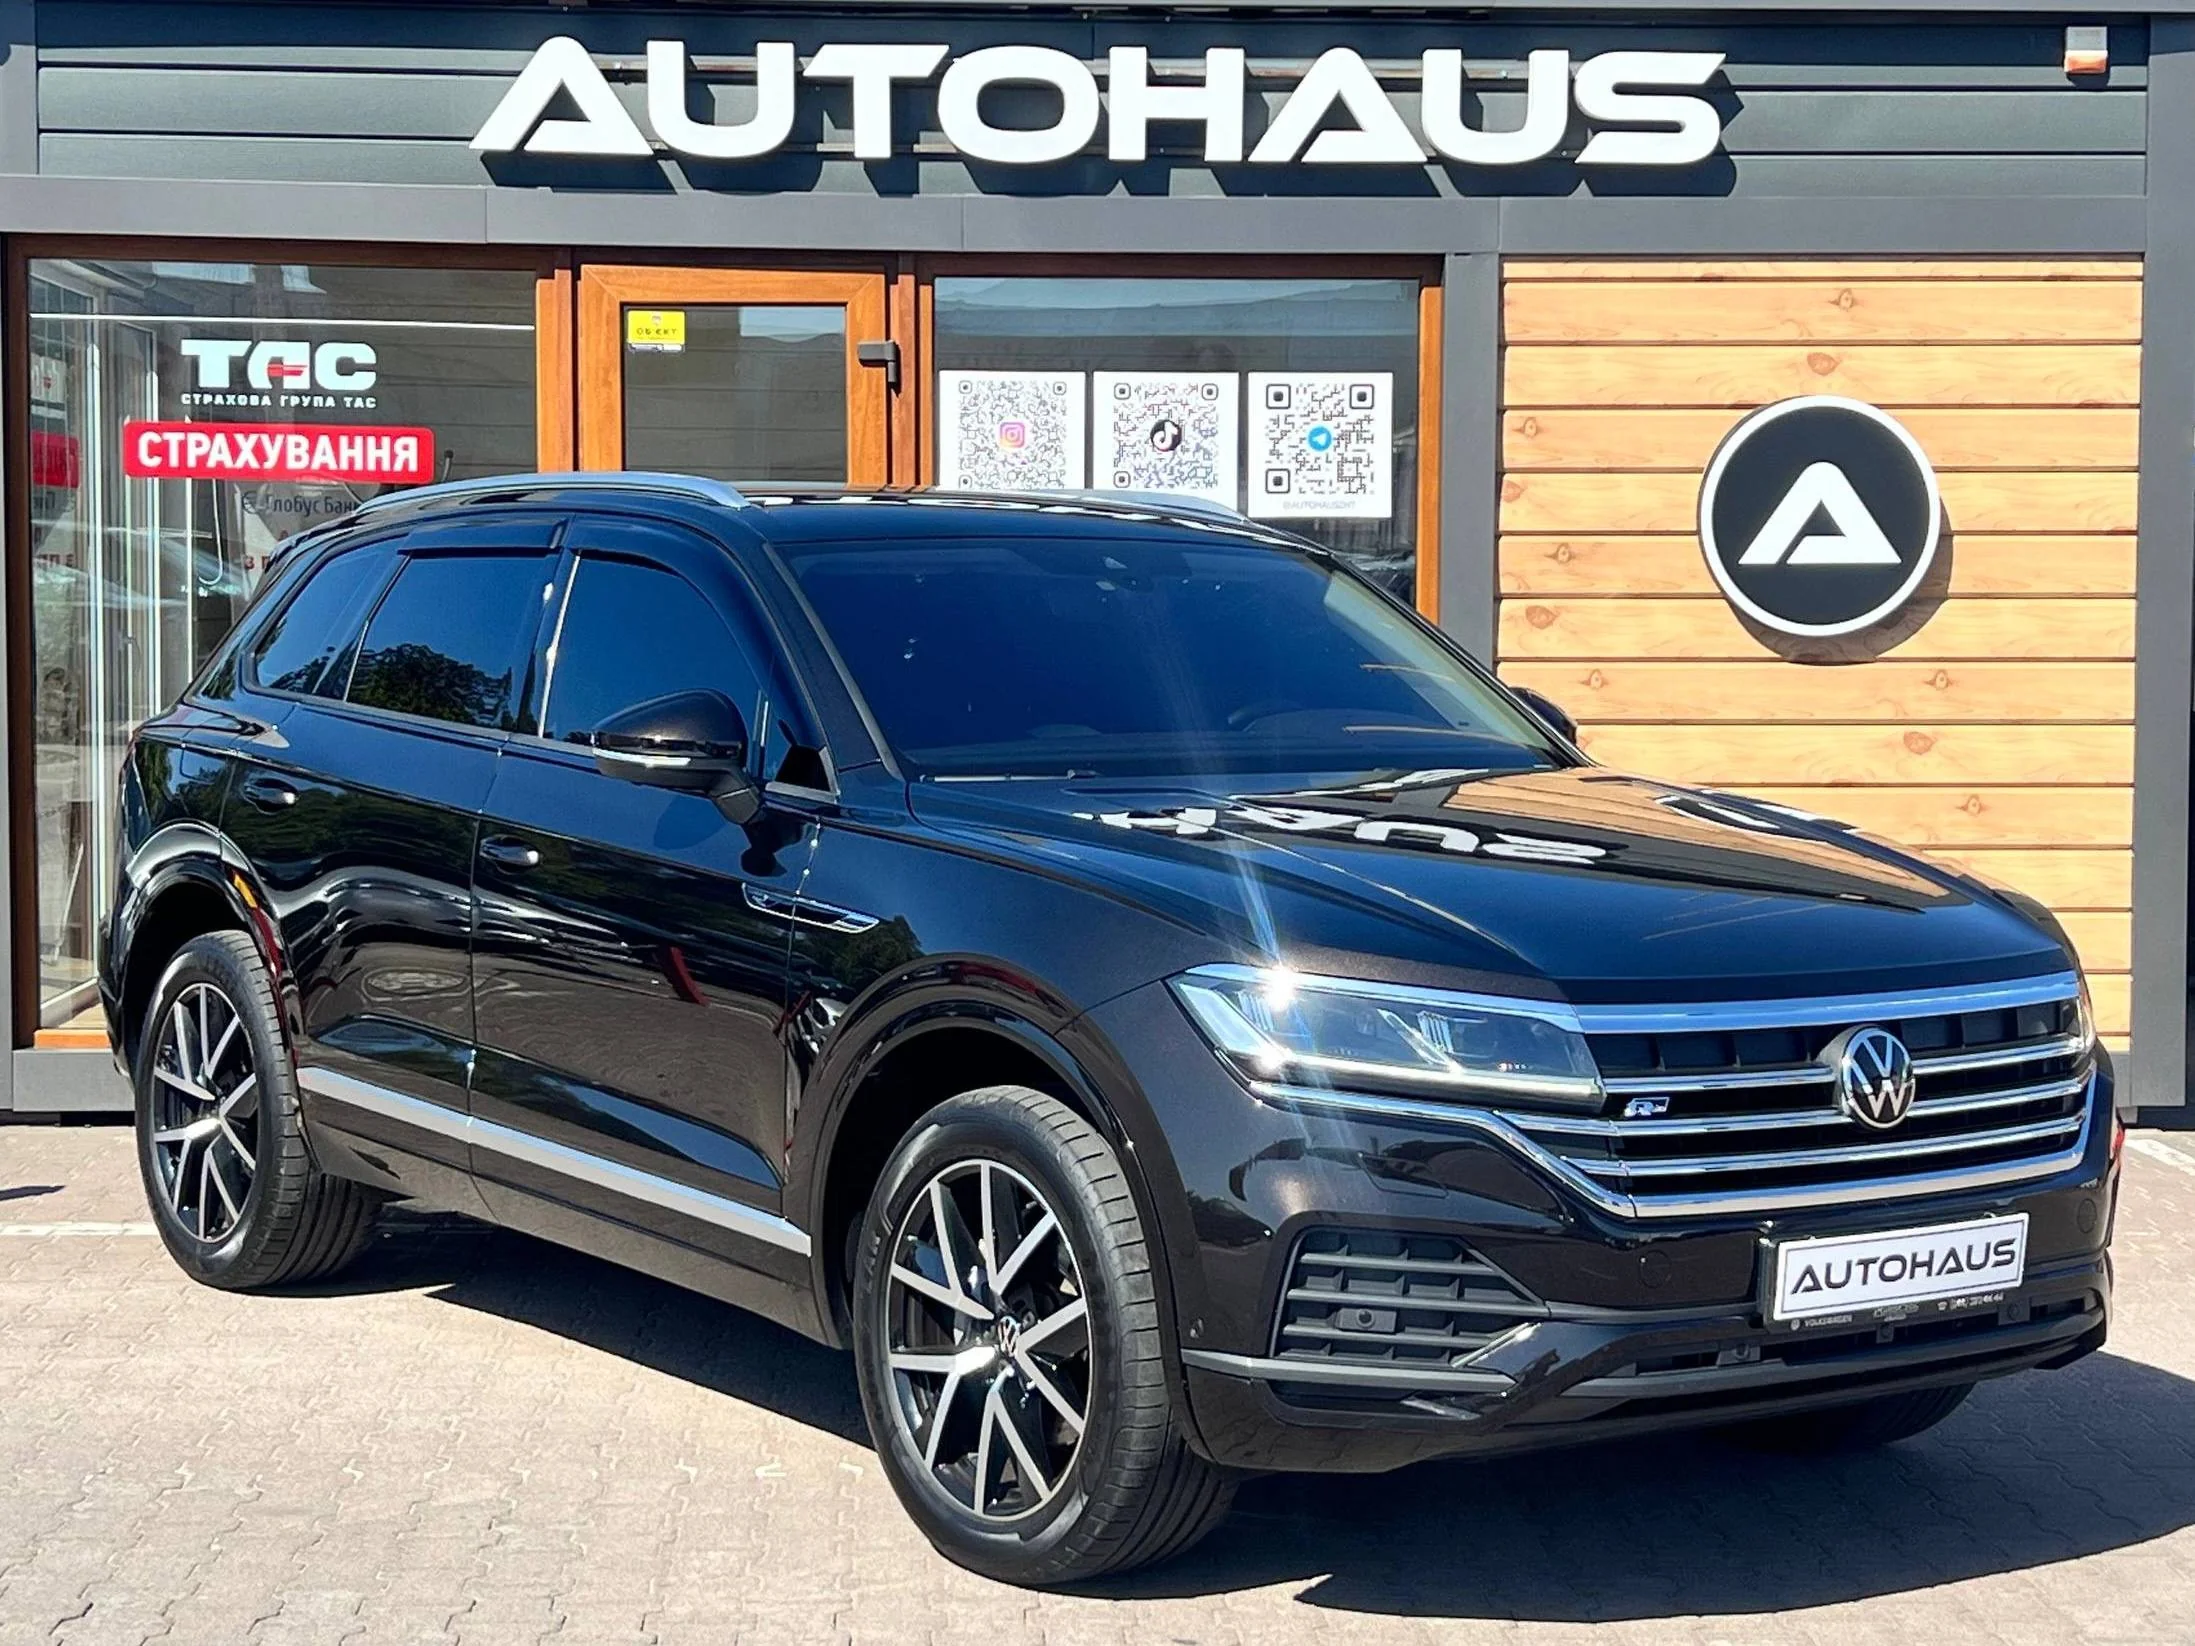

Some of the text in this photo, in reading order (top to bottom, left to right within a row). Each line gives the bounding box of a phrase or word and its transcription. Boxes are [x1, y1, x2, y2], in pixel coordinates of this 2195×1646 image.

[470, 36, 1727, 165] AUTOHAUS
[180, 393, 377, 409] СТРАХОВА ГРУПА ТАС
[138, 430, 419, 473] СТРАХУВАННЯ
[1791, 1238, 2016, 1295] AUTOHAUS
